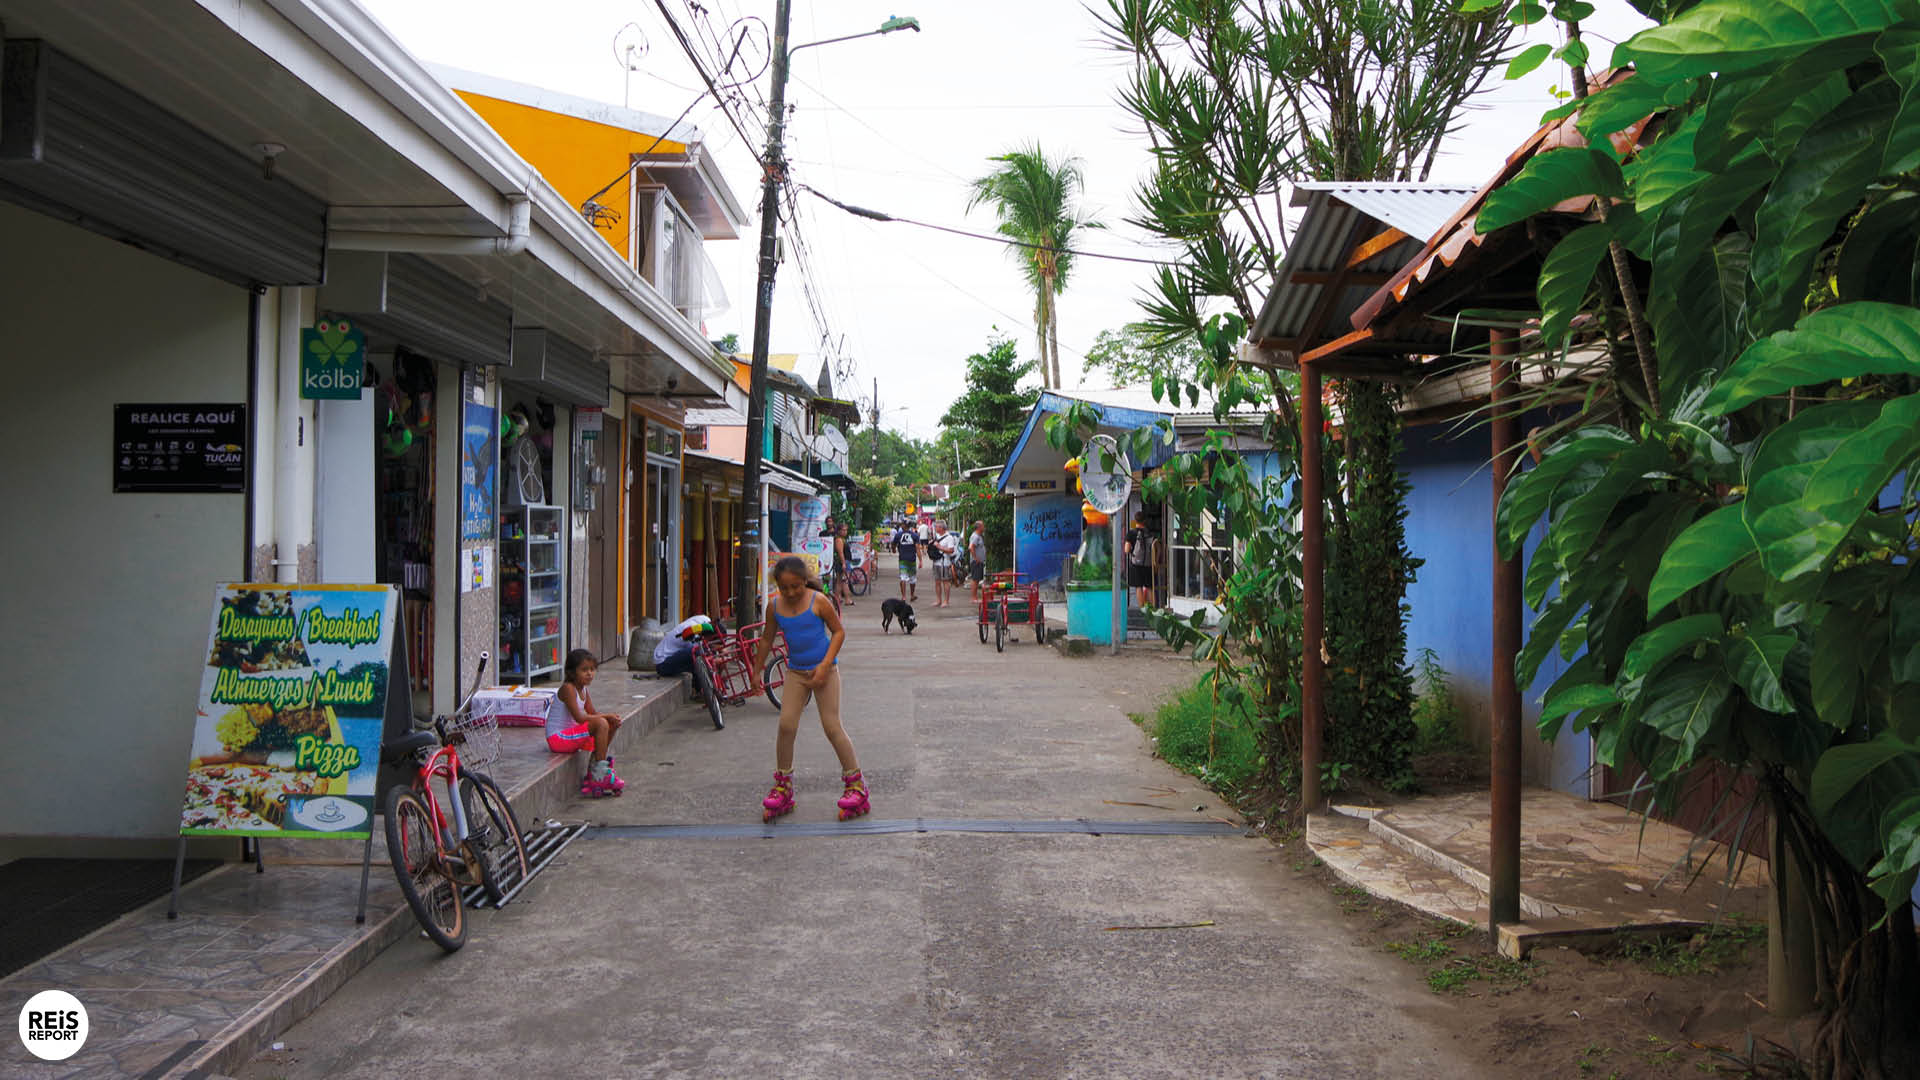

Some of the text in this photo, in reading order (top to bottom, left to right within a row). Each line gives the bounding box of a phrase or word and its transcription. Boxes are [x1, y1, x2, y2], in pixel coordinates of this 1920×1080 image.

[305, 367, 360, 388] kölbi
[131, 410, 235, 424] REALICE AQUÍ
[220, 607, 296, 644] Desayunos
[308, 605, 381, 648] Breakfast
[212, 668, 304, 710] Almuerzos
[321, 668, 375, 702] Lunch
[296, 734, 360, 776] Pizza
